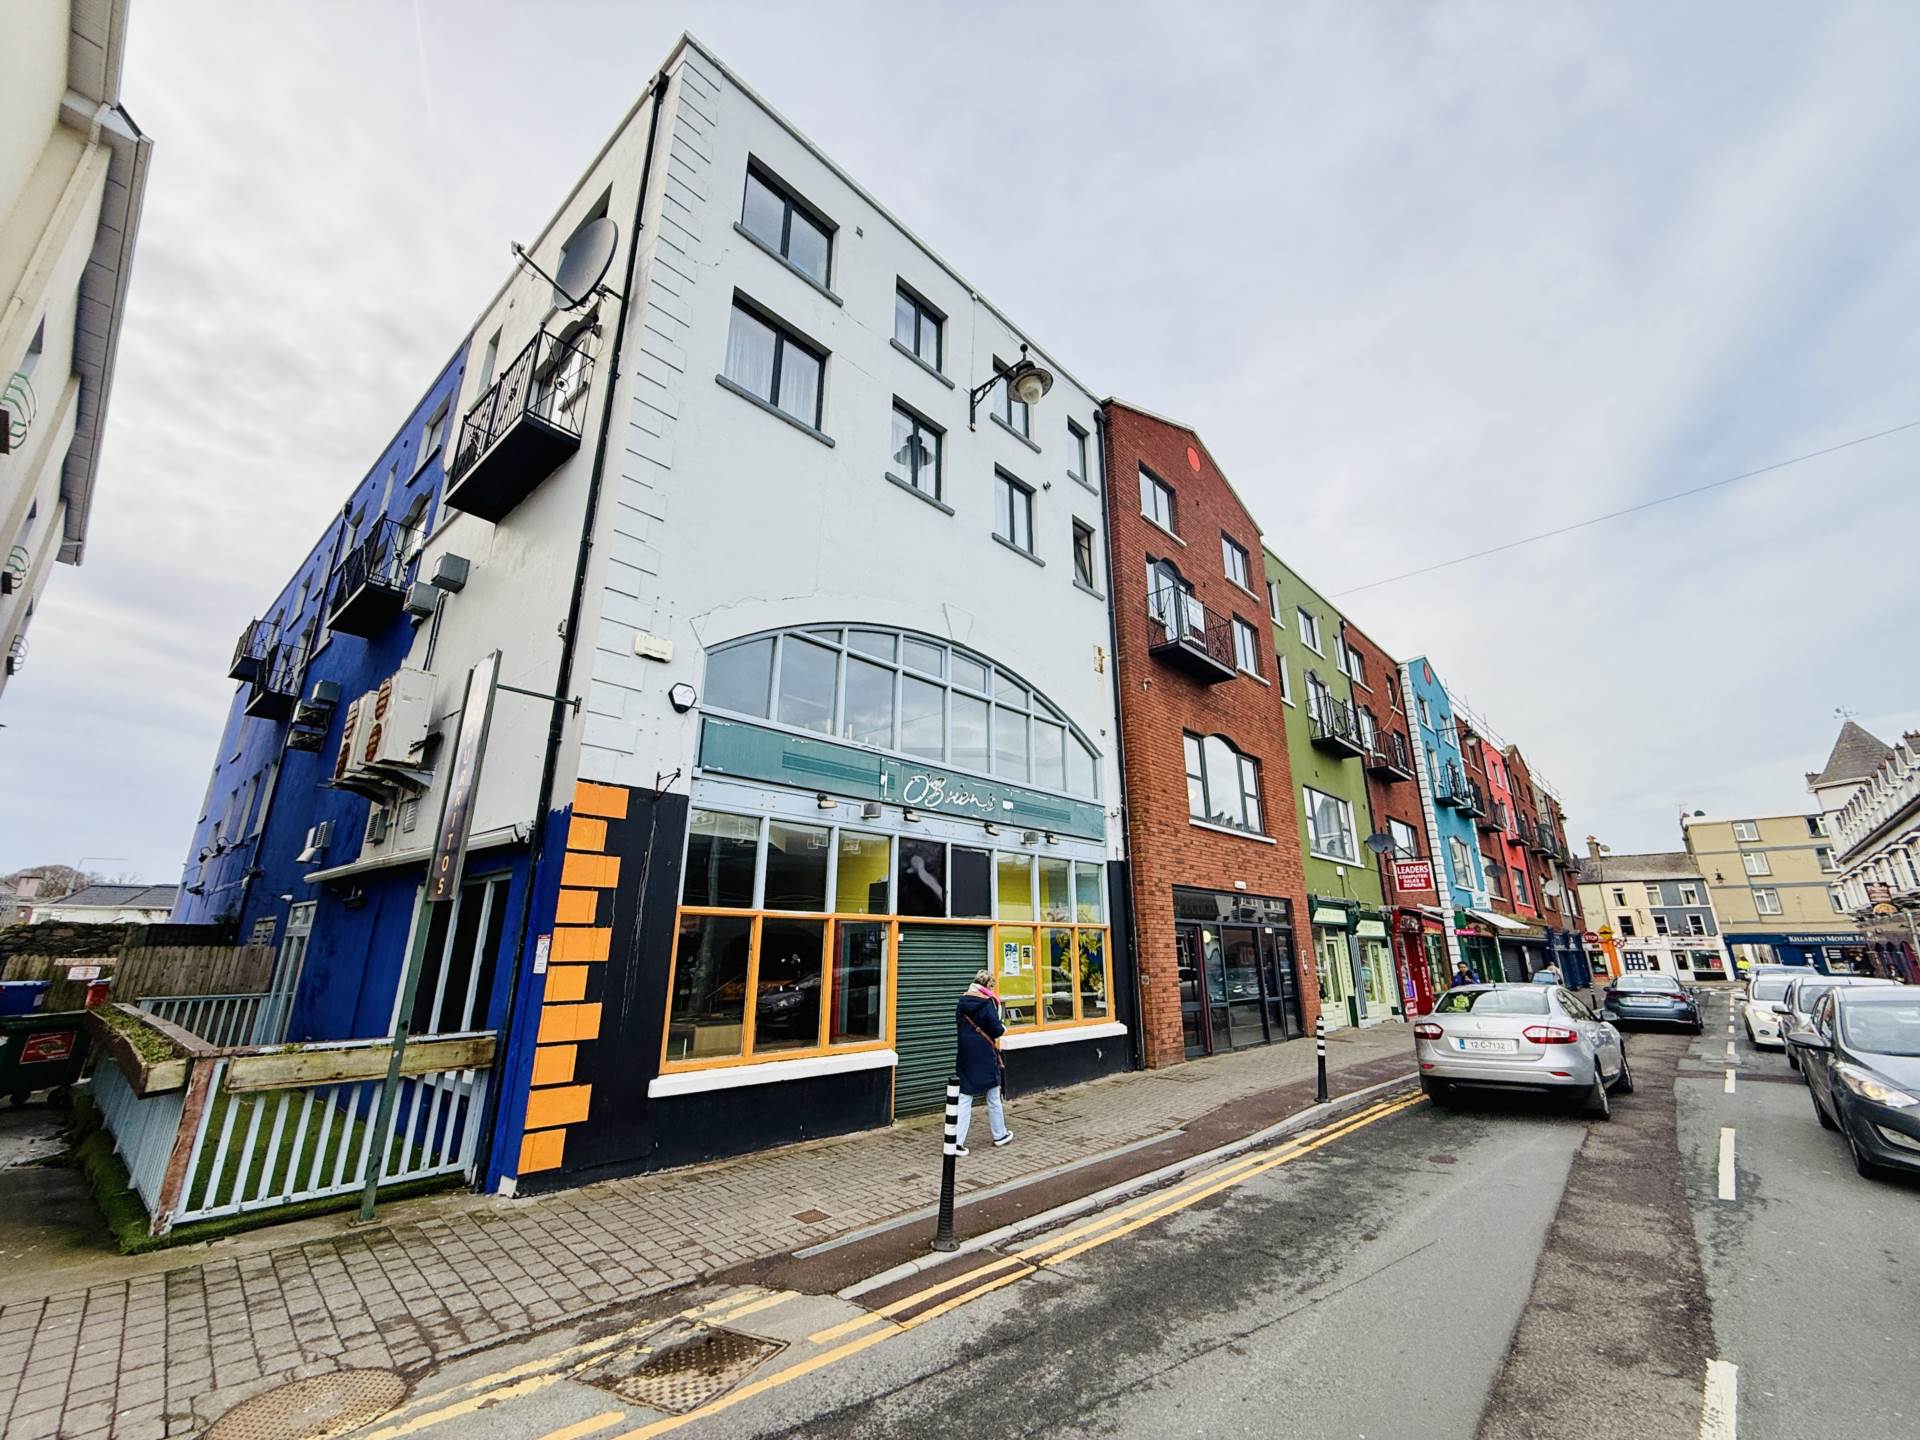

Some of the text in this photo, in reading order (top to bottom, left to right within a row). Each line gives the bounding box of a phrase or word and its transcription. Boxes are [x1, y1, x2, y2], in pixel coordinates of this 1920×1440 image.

[437, 727, 475, 895] BURRITOS
[1397, 865, 1429, 874] LEADERS
[1788, 935, 1826, 943] KILLARNEY
